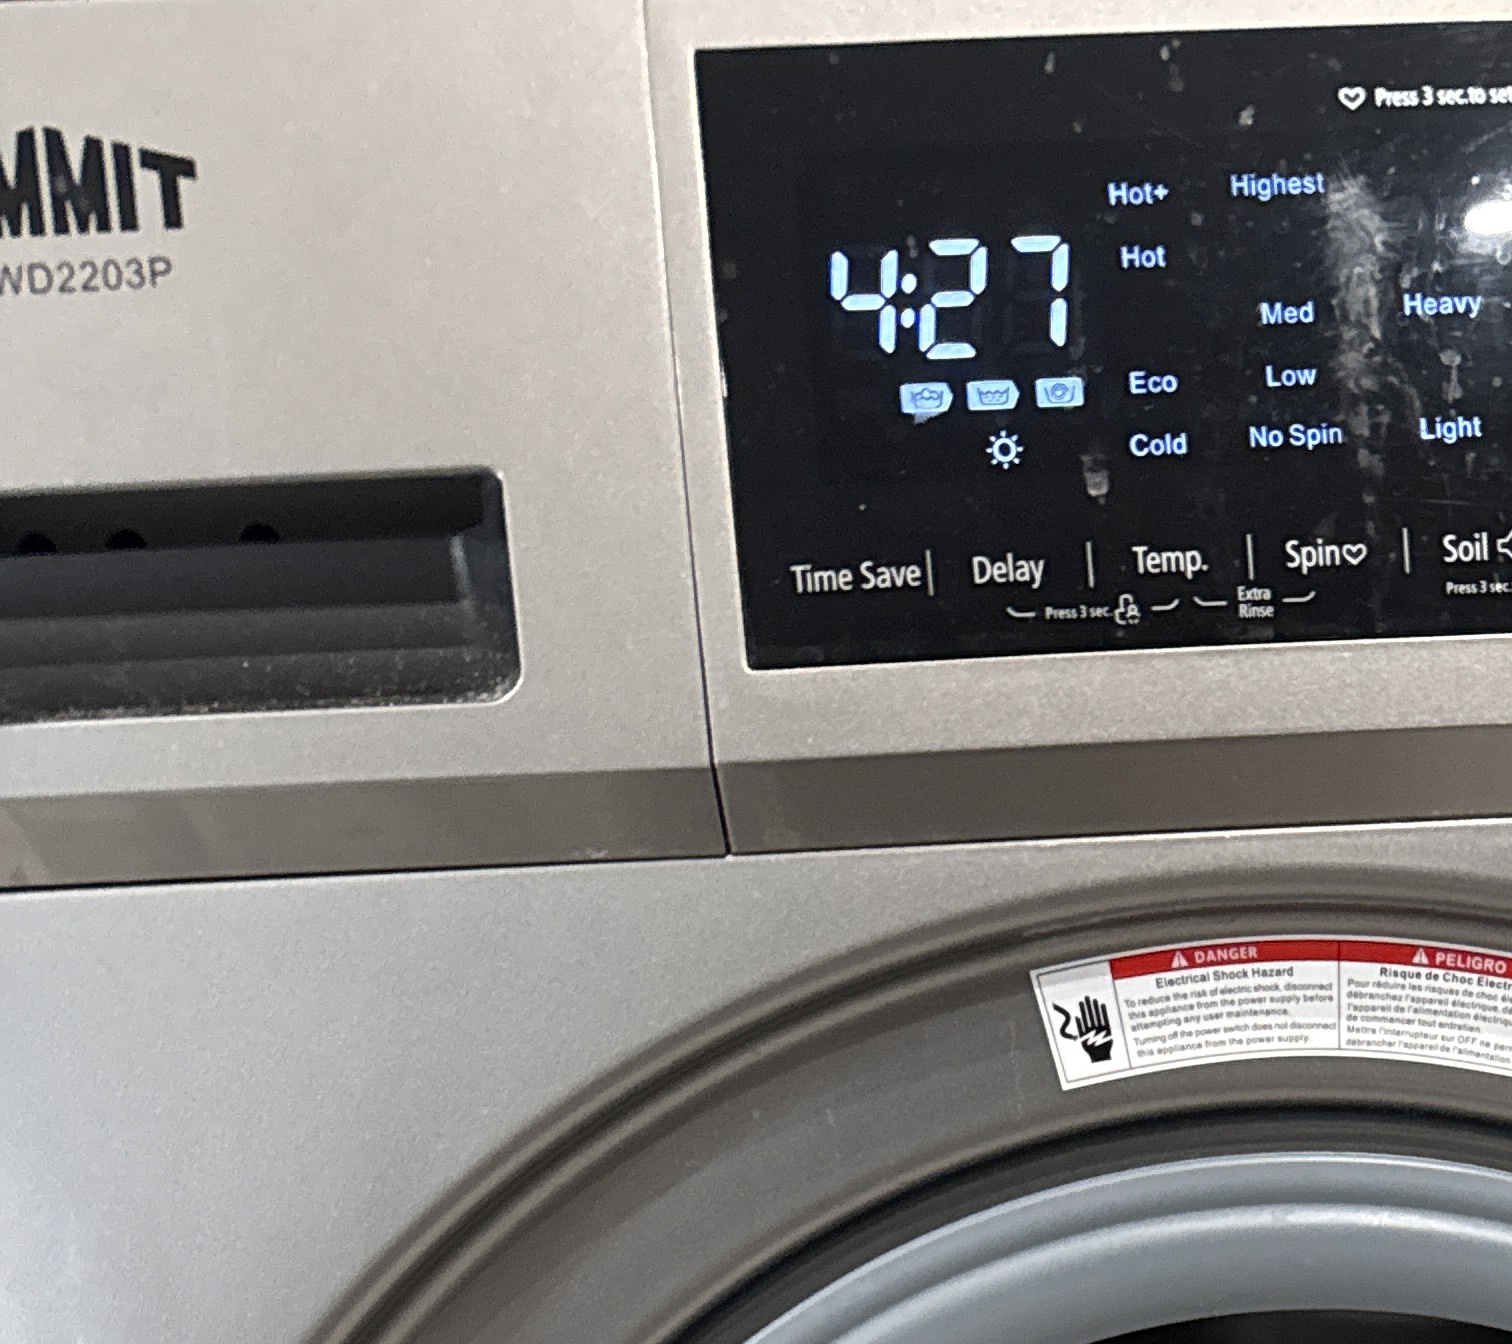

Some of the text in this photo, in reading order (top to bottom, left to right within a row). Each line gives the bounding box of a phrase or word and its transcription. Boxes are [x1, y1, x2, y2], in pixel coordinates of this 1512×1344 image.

[1374, 87, 1419, 107] Press
[1421, 86, 1433, 105] 3
[1108, 182, 1168, 205] Hot+
[1231, 173, 1325, 201] Highest
[1121, 246, 1166, 268] Hot
[831, 235, 1069, 359] 4:27
[1403, 293, 1483, 320] Heavy
[1260, 301, 1314, 324] Med
[1129, 371, 1177, 394] Eco
[1266, 366, 1316, 387] Low
[1249, 423, 1342, 450] No Spin
[1419, 416, 1482, 444] Light
[1130, 433, 1187, 456] Cold
[1286, 538, 1343, 574] Spin
[1443, 532, 1488, 562] Soil
[973, 554, 1044, 588] Delay
[1132, 546, 1208, 577] Temp.
[790, 561, 921, 593] Time Save
[1446, 582, 1477, 594] Press
[1480, 581, 1487, 593] 3
[1238, 586, 1271, 601] Extra
[1045, 607, 1077, 619] Press
[1080, 605, 1086, 618] 3
[1238, 603, 1274, 618] Rinse
[1194, 946, 1258, 964] DANGER
[1436, 952, 1506, 974] PELIGRO
[1155, 966, 1294, 988] Electrical Shock Hazard
[1380, 967, 1422, 980] Risque
[1425, 970, 1439, 981] de
[1443, 973, 1474, 986] Choc
